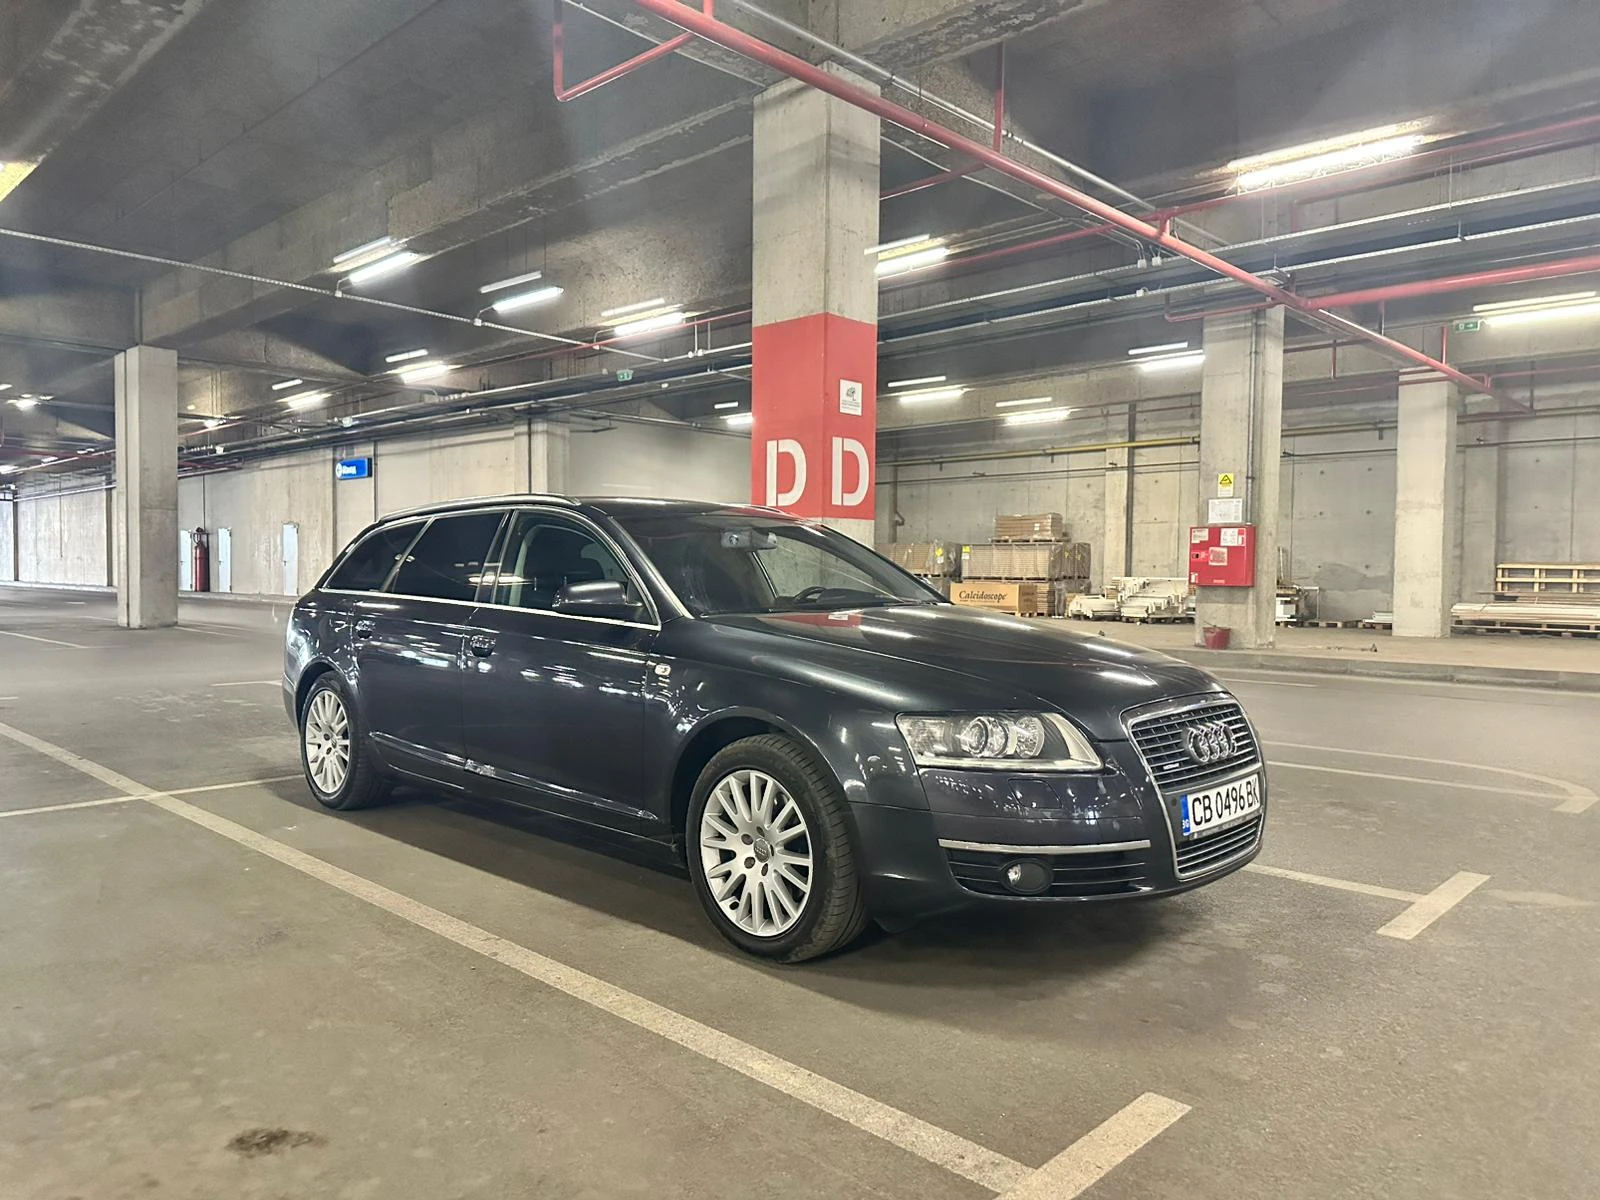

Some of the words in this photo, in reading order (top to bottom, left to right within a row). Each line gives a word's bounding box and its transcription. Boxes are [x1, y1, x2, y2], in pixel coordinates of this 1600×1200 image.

[766, 439, 806, 506] D
[832, 436, 869, 506] D
[959, 590, 1008, 603] Caleidoscope
[1192, 795, 1212, 825] CB
[1215, 784, 1245, 818] 0496
